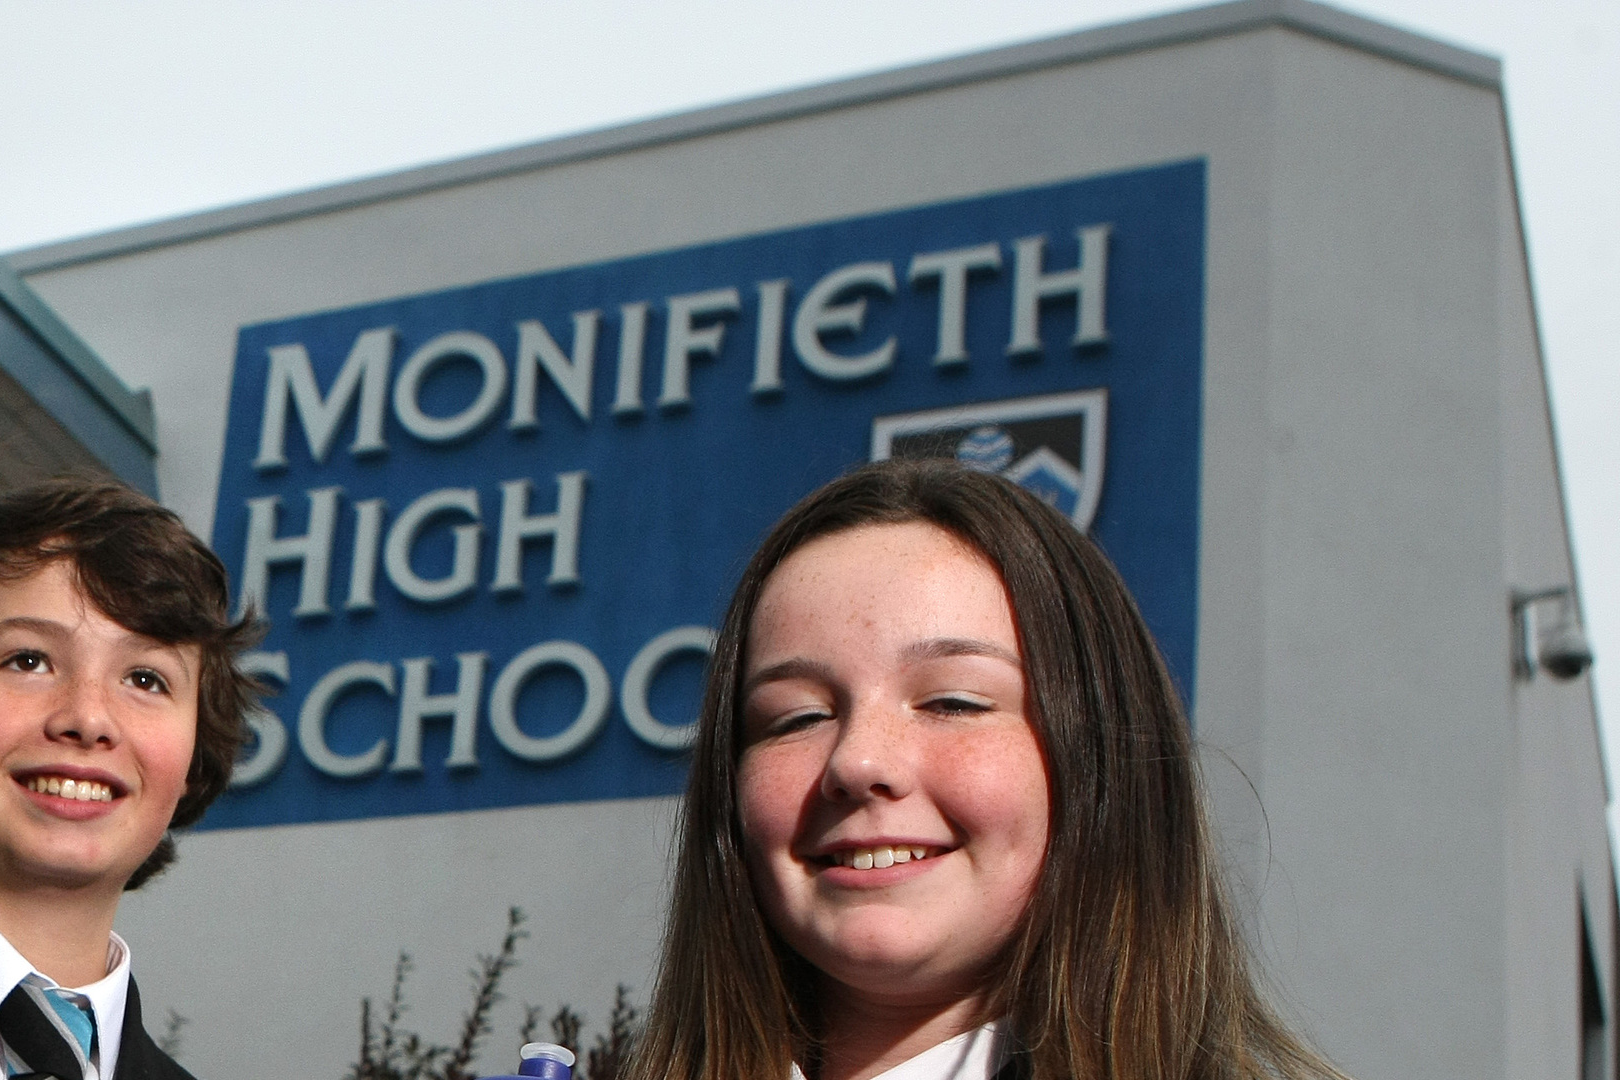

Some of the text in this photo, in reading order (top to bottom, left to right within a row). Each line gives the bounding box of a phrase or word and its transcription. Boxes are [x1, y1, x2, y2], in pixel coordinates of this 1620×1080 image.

[253, 222, 1114, 470] MONIFIETH
[239, 470, 588, 622] HIGH
[228, 624, 716, 789] SCHOO
